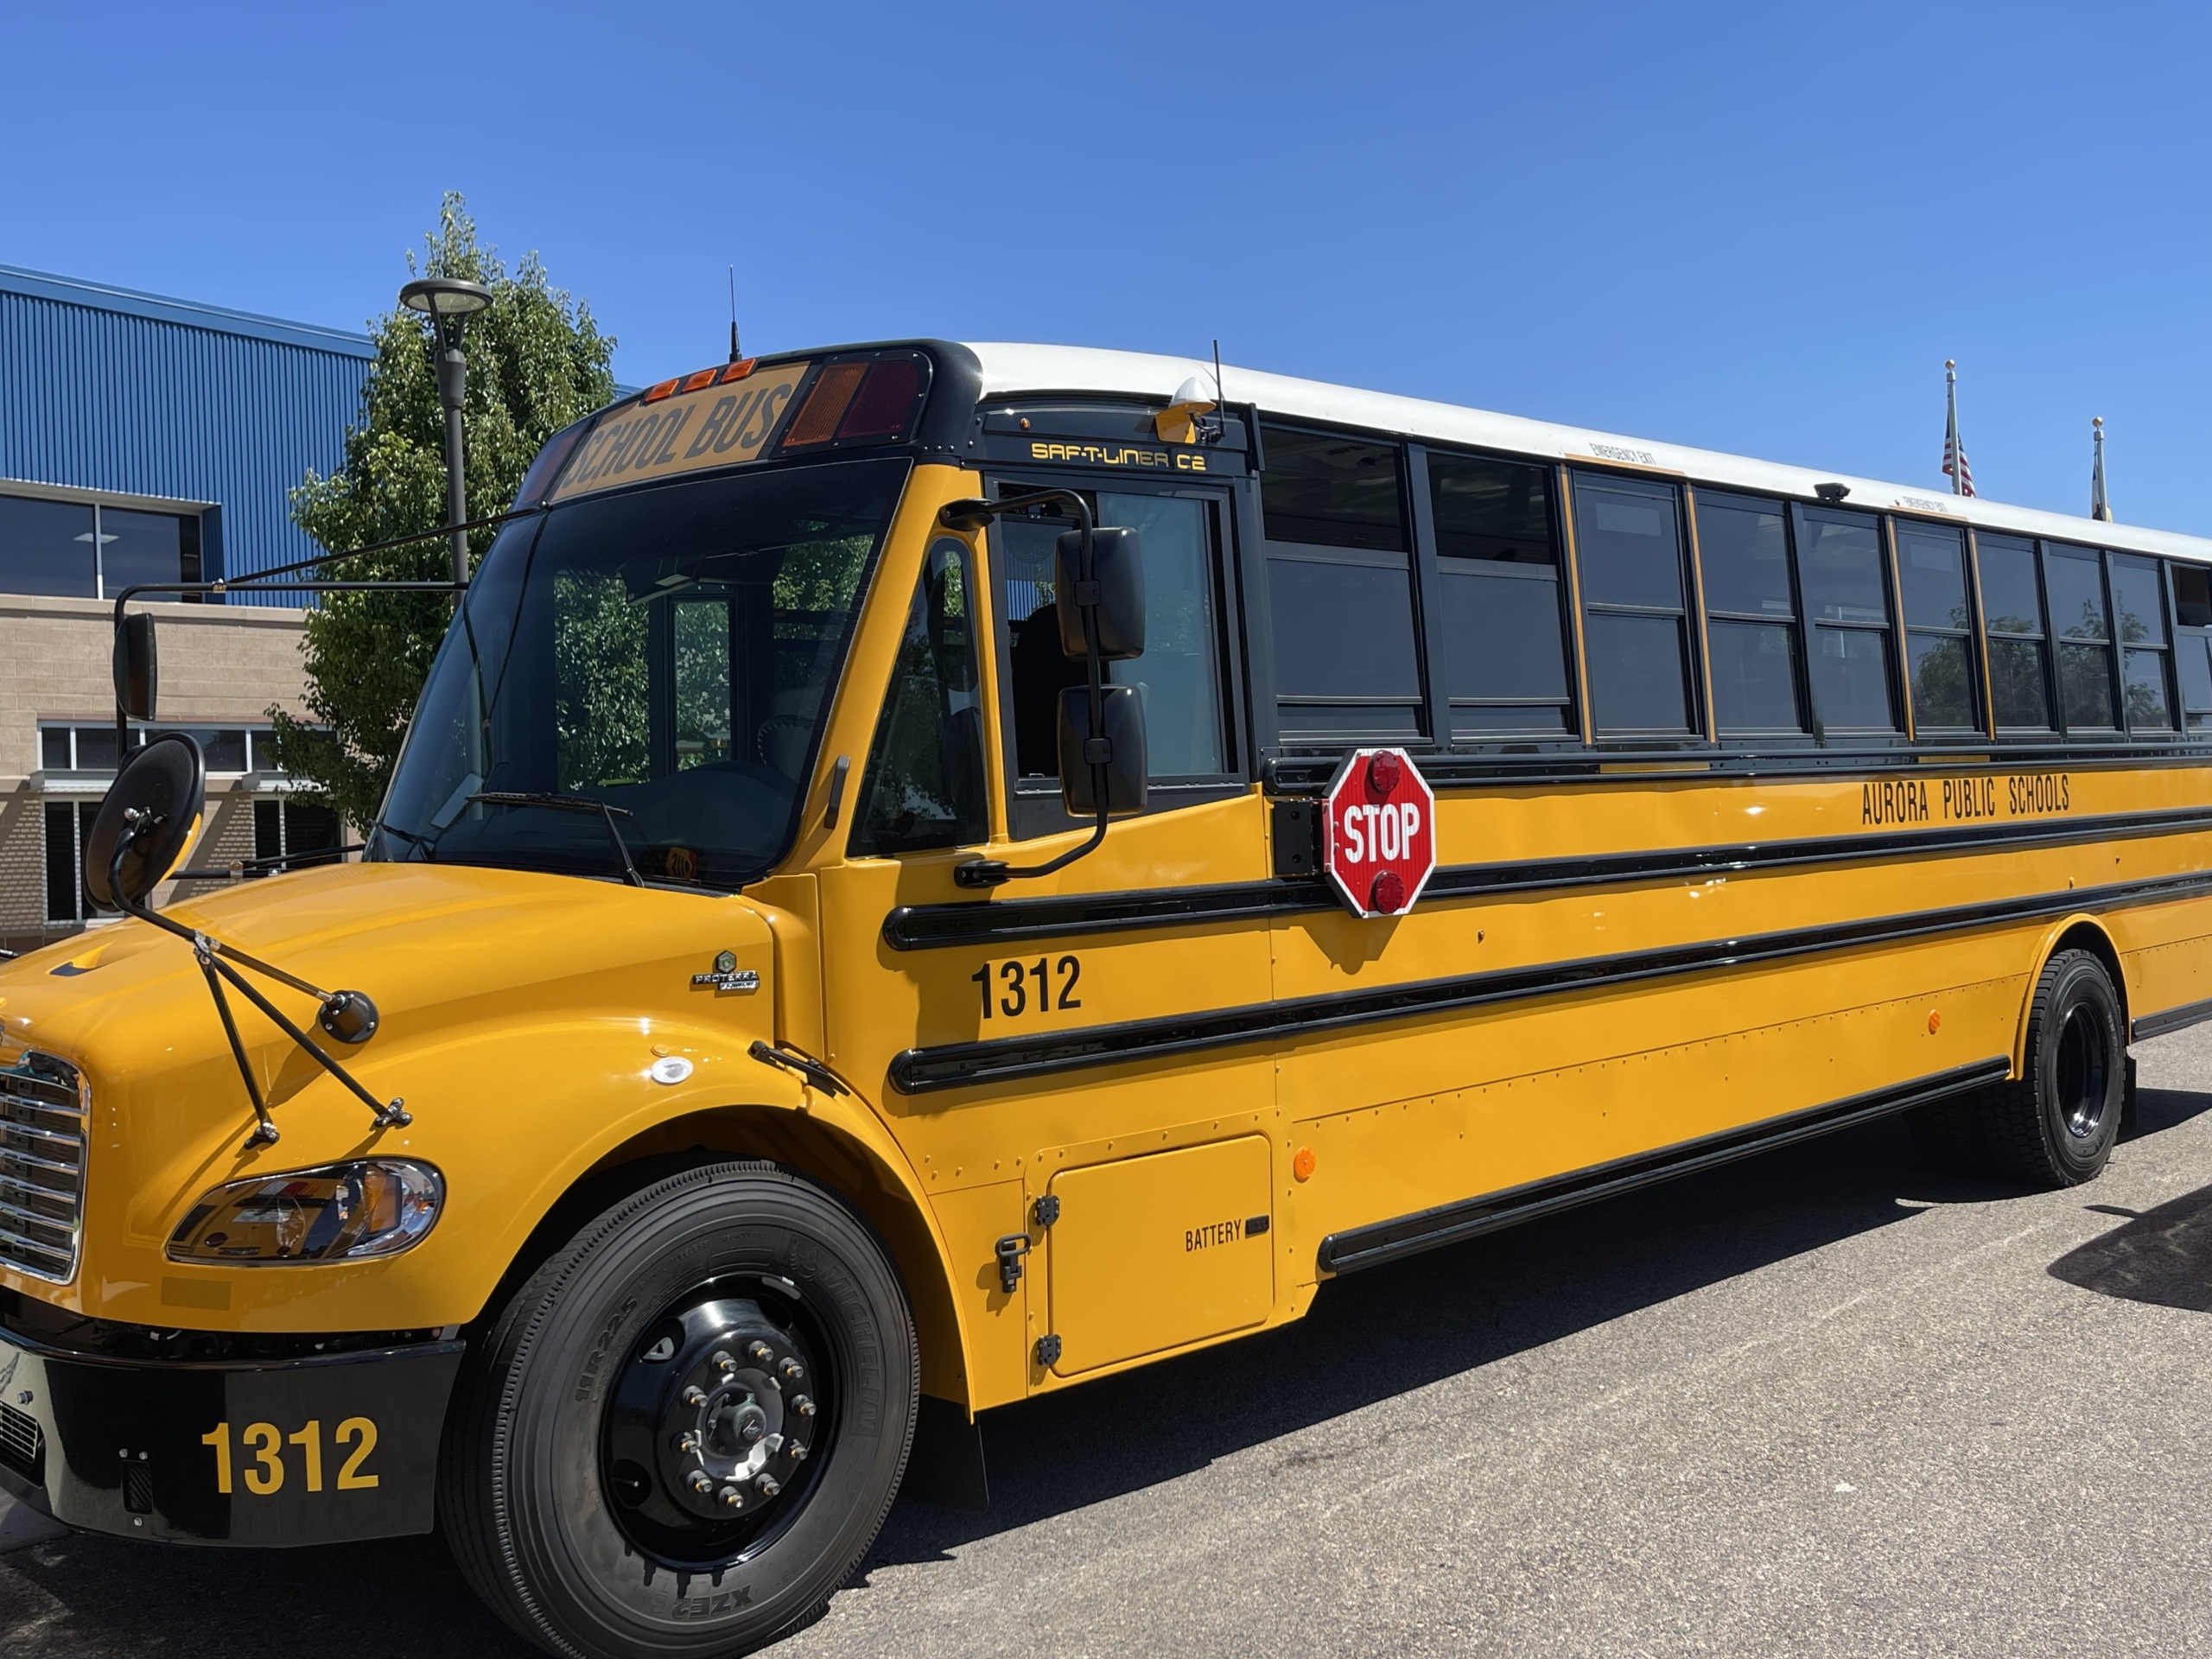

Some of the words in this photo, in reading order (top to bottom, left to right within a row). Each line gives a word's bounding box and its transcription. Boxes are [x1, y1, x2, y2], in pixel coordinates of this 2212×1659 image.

[563, 407, 692, 489] SCHOOL
[683, 384, 792, 459] BUS
[1031, 443, 1169, 467] SAF-T-LINER
[1176, 454, 1207, 471] C2
[1589, 442, 1639, 462] EMERGENCY
[1636, 450, 1656, 466] EXIT
[1862, 781, 1929, 824] AURORA
[1943, 778, 1995, 819] PUBLIC
[2009, 774, 2069, 814] SCHOOLS
[1344, 802, 1420, 863] STOP
[971, 956, 1081, 1019] 1312
[1185, 1219, 1242, 1252] BATTERY
[822, 1264, 880, 1432] MICHELIN
[201, 1417, 379, 1495] 1312
[671, 1585, 753, 1620] XZE2
